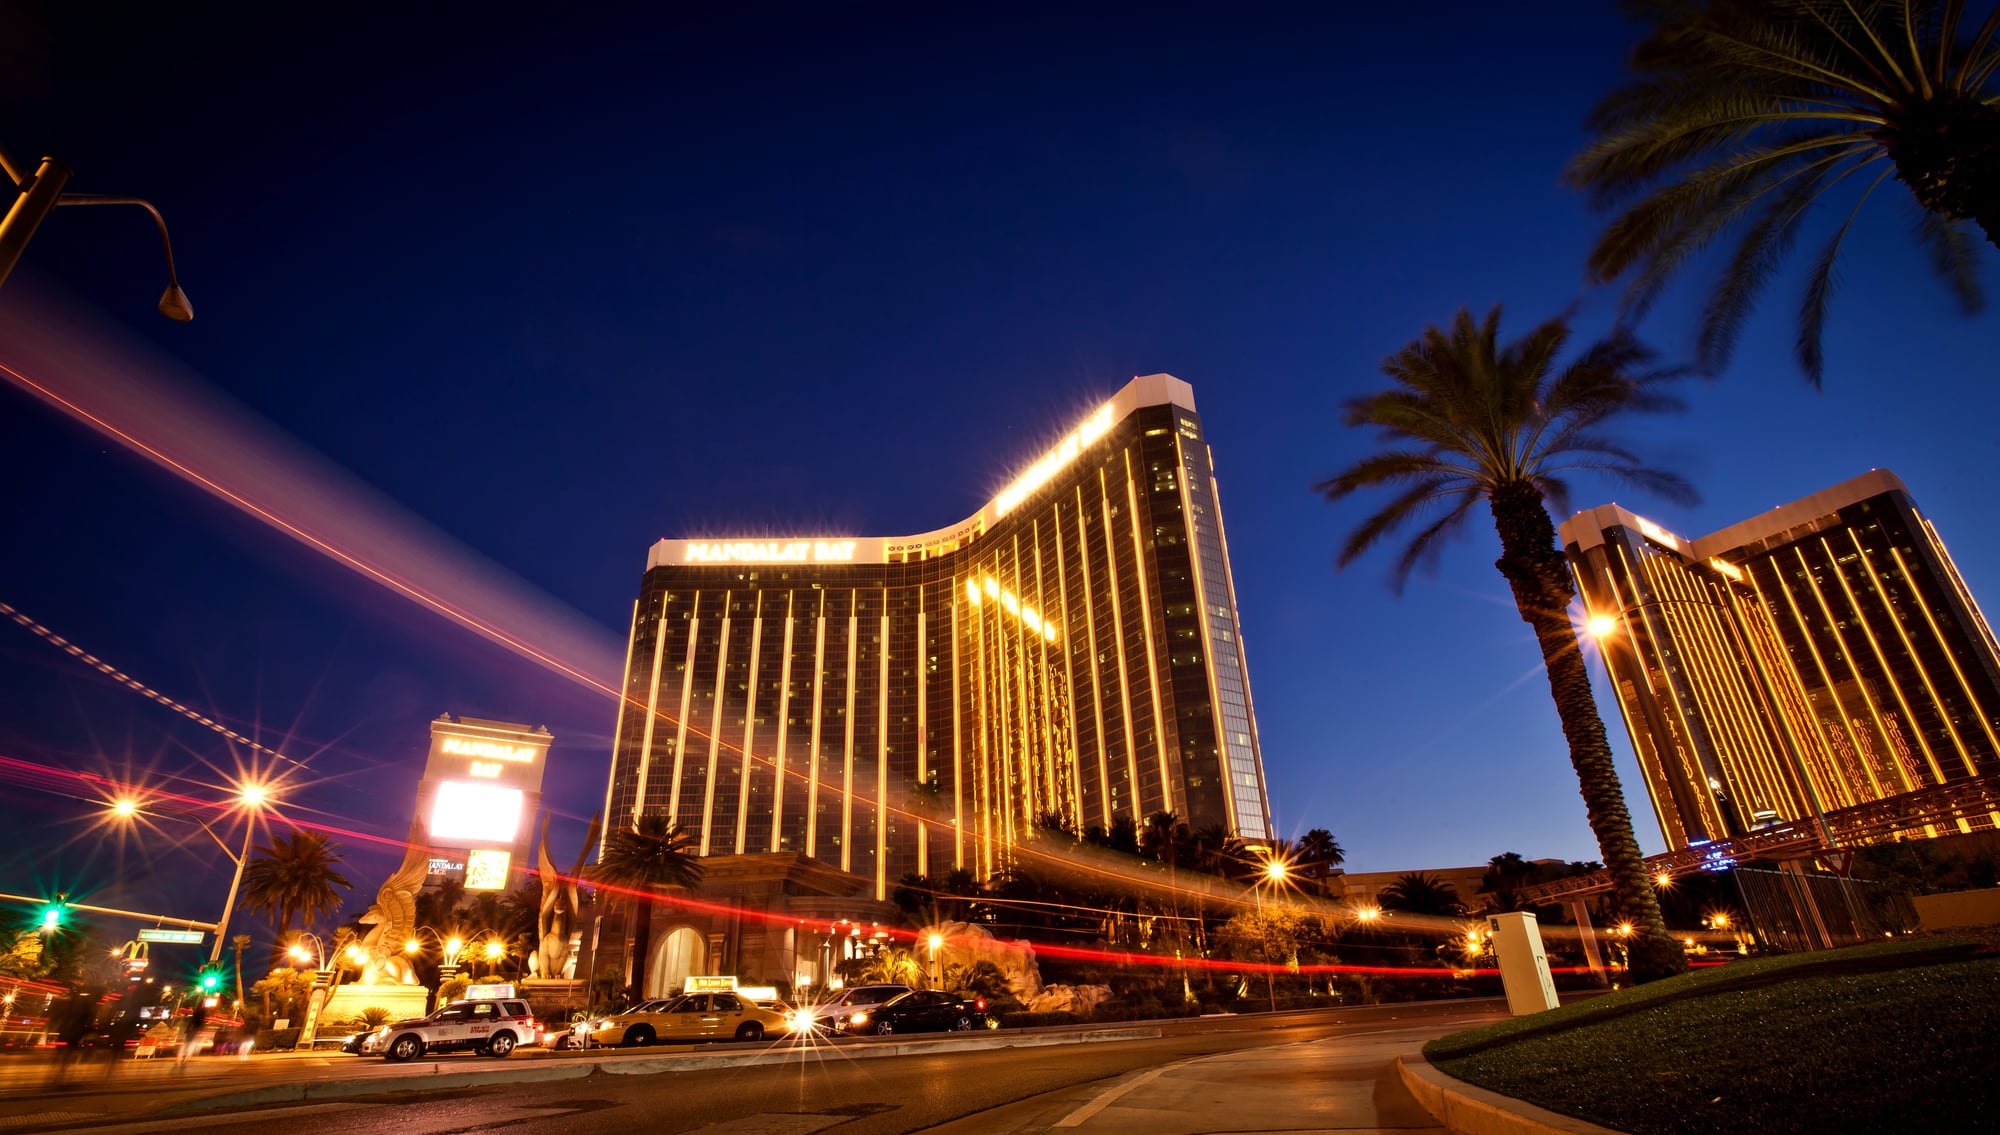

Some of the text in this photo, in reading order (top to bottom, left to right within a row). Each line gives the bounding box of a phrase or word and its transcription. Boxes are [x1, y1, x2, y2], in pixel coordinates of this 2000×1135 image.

[1080, 404, 1113, 447] BAY
[685, 541, 857, 562] MANDALAY BAY
[443, 739, 536, 762] MANDALAY
[470, 762, 503, 777] BAY
